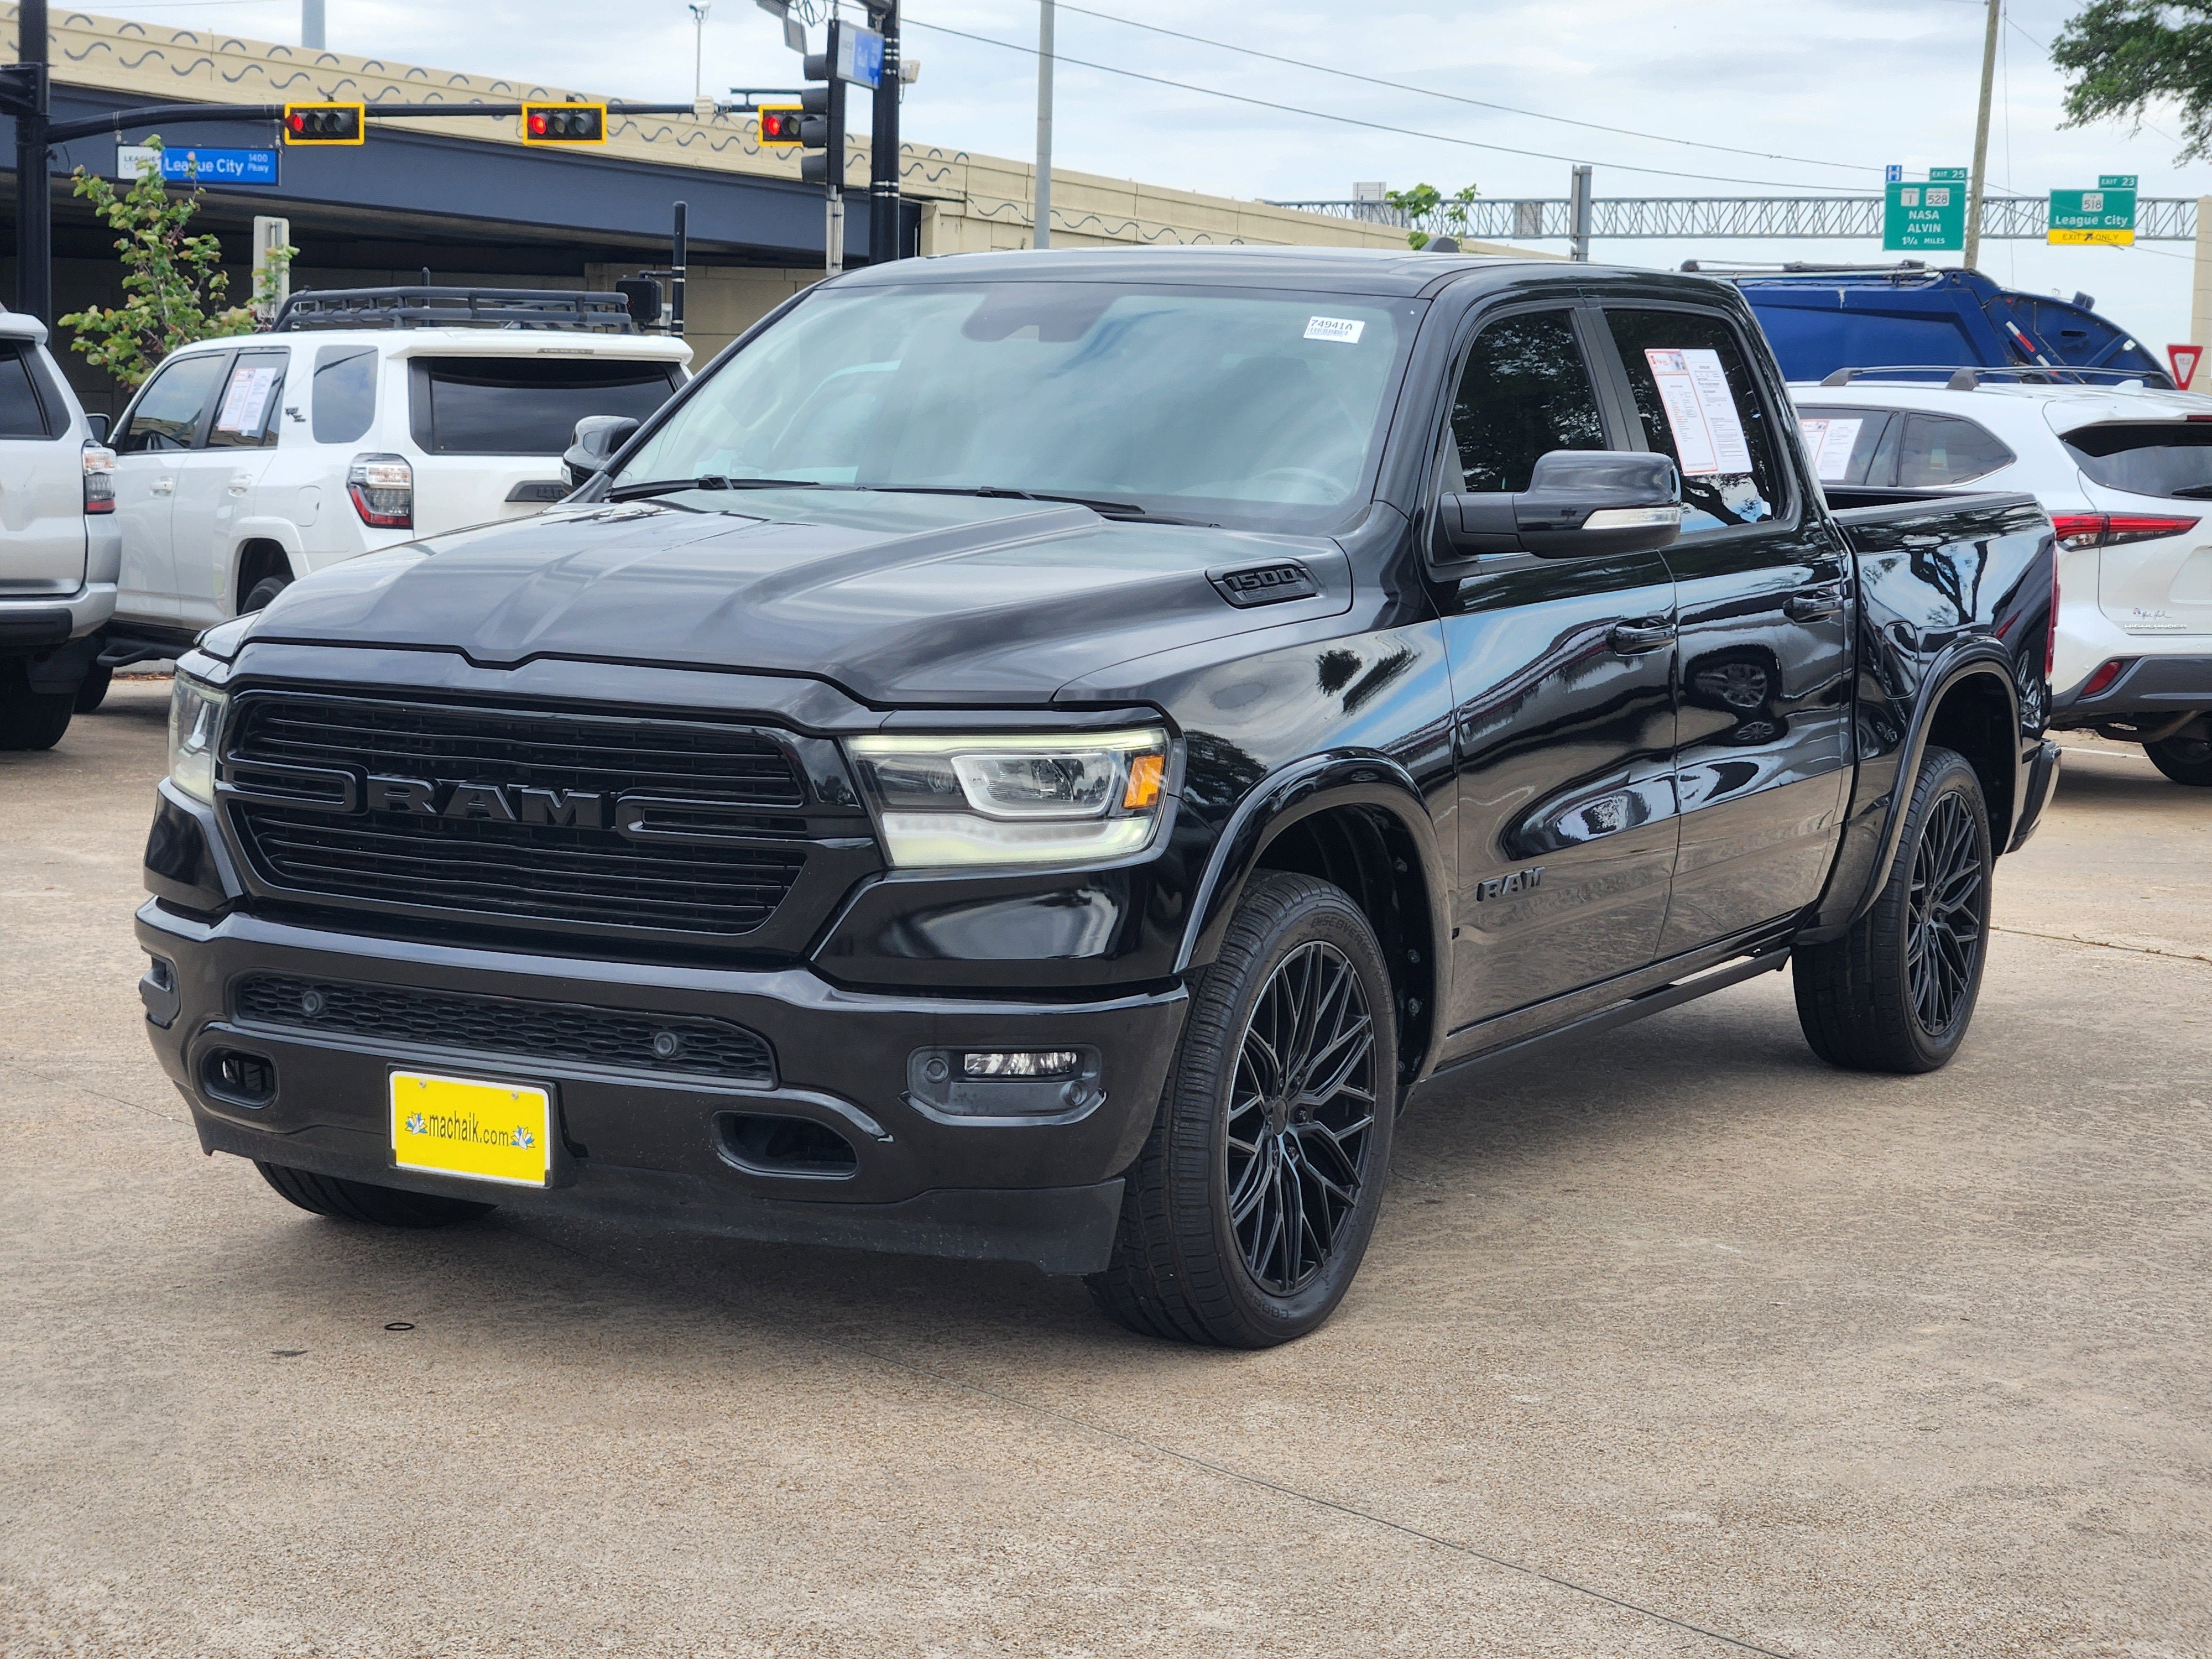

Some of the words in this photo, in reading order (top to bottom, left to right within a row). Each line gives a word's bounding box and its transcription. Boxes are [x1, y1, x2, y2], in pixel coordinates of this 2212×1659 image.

[248, 154, 269, 163] 1400
[166, 158, 213, 172] Leaue
[217, 158, 244, 176] City
[1952, 170, 1965, 179] 25
[2122, 177, 2135, 186] 23
[1928, 195, 1948, 204] 528
[2084, 200, 2101, 209] 518
[1908, 210, 1939, 220] NASA
[2056, 215, 2099, 227] League
[2104, 215, 2128, 227] City
[1907, 223, 1942, 232] ALVIN
[1311, 319, 1353, 331] 74941A
[1225, 567, 1300, 590] 1500
[367, 774, 602, 828] RAM
[1476, 866, 1546, 901] RAM
[429, 1110, 509, 1146] machaik.com
